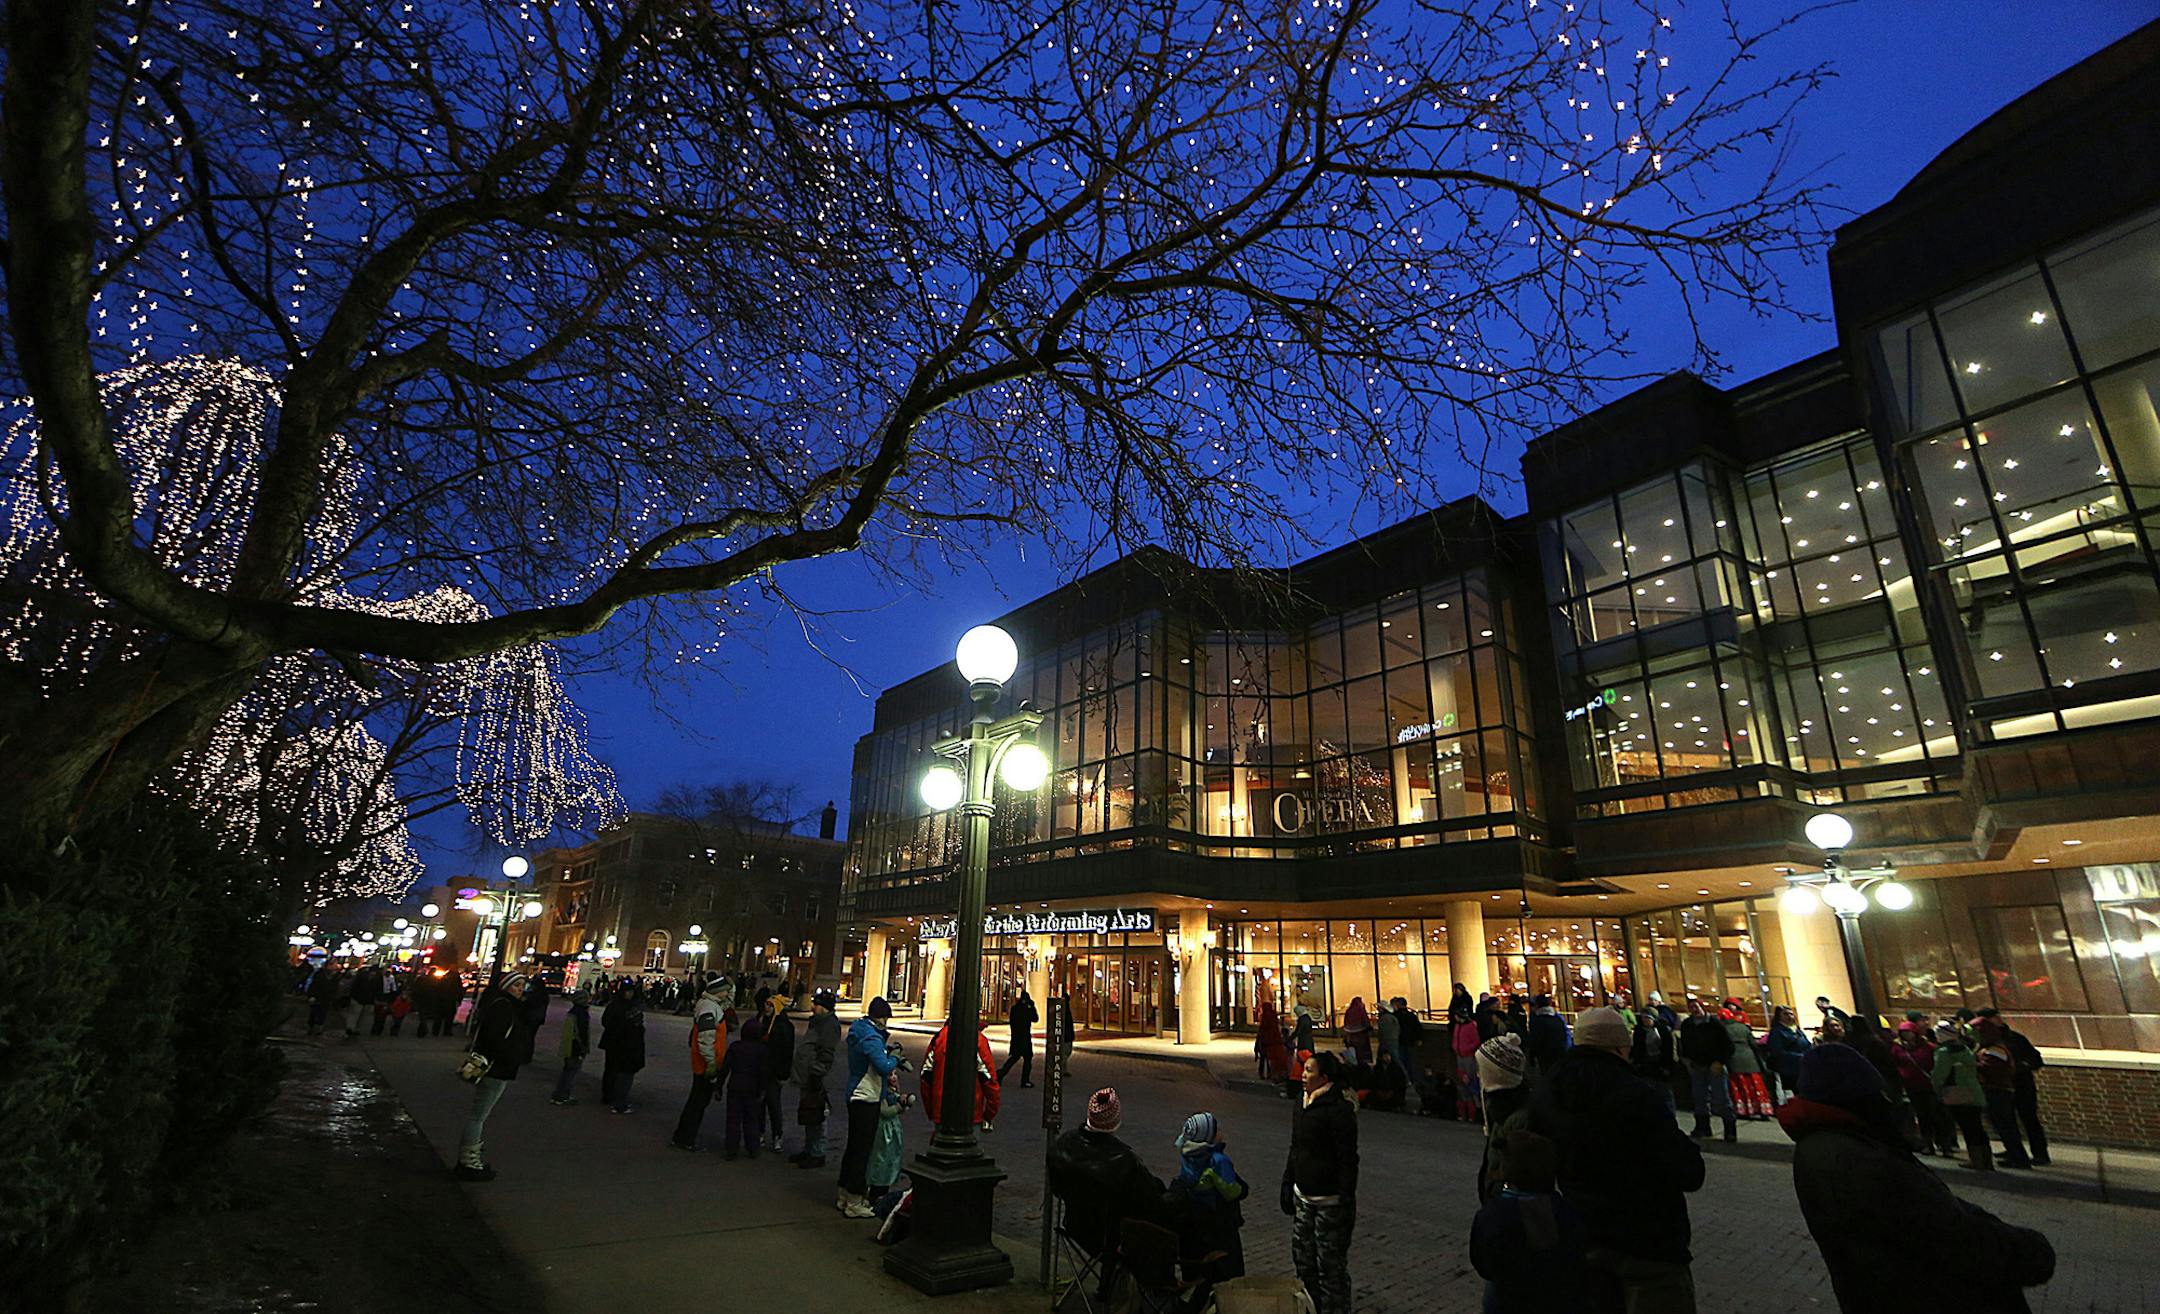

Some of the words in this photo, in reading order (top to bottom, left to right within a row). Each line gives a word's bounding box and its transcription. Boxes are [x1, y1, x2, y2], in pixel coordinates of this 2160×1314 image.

[1003, 915, 1023, 933] the
[1025, 911, 1108, 935] Performing
[1109, 907, 1152, 930] Arts
[1054, 1004, 1062, 1052] PERMIT
[1052, 1055, 1061, 1112] PARKING
